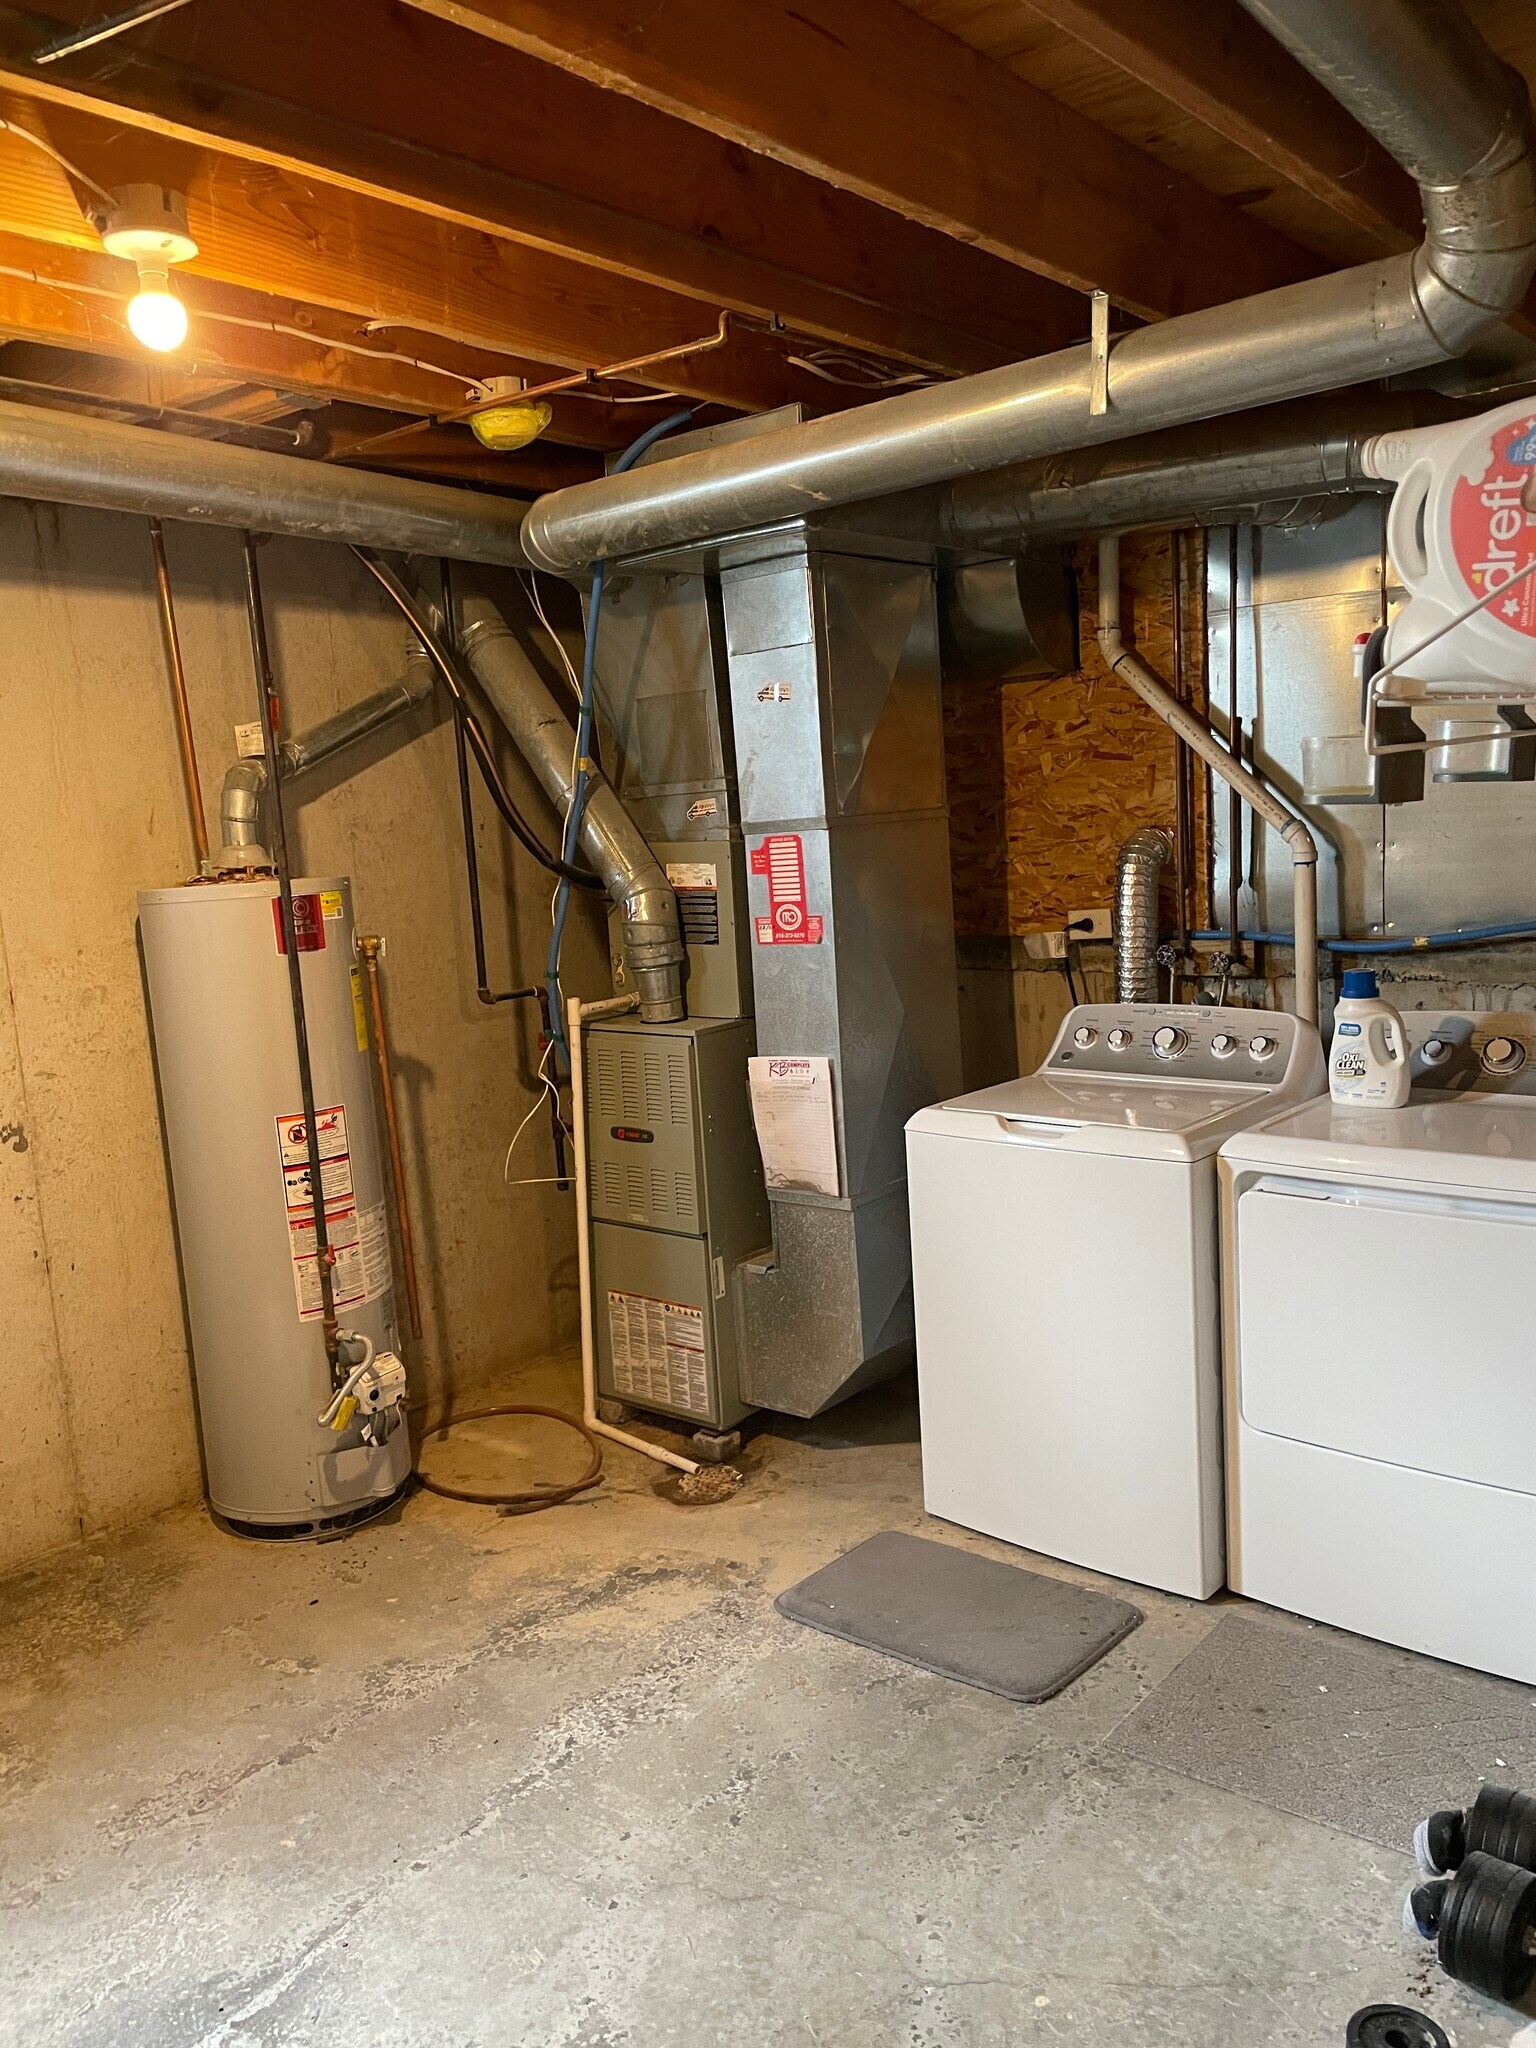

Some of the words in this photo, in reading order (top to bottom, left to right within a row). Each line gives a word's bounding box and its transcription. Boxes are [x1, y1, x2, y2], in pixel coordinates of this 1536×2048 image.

[1471, 472, 1529, 594] dreft
[1520, 607, 1529, 627] Ultra
[1336, 1060, 1364, 1070] CLEAN
[1341, 1052, 1359, 1061] OXI
[769, 1061, 789, 1078] KB
